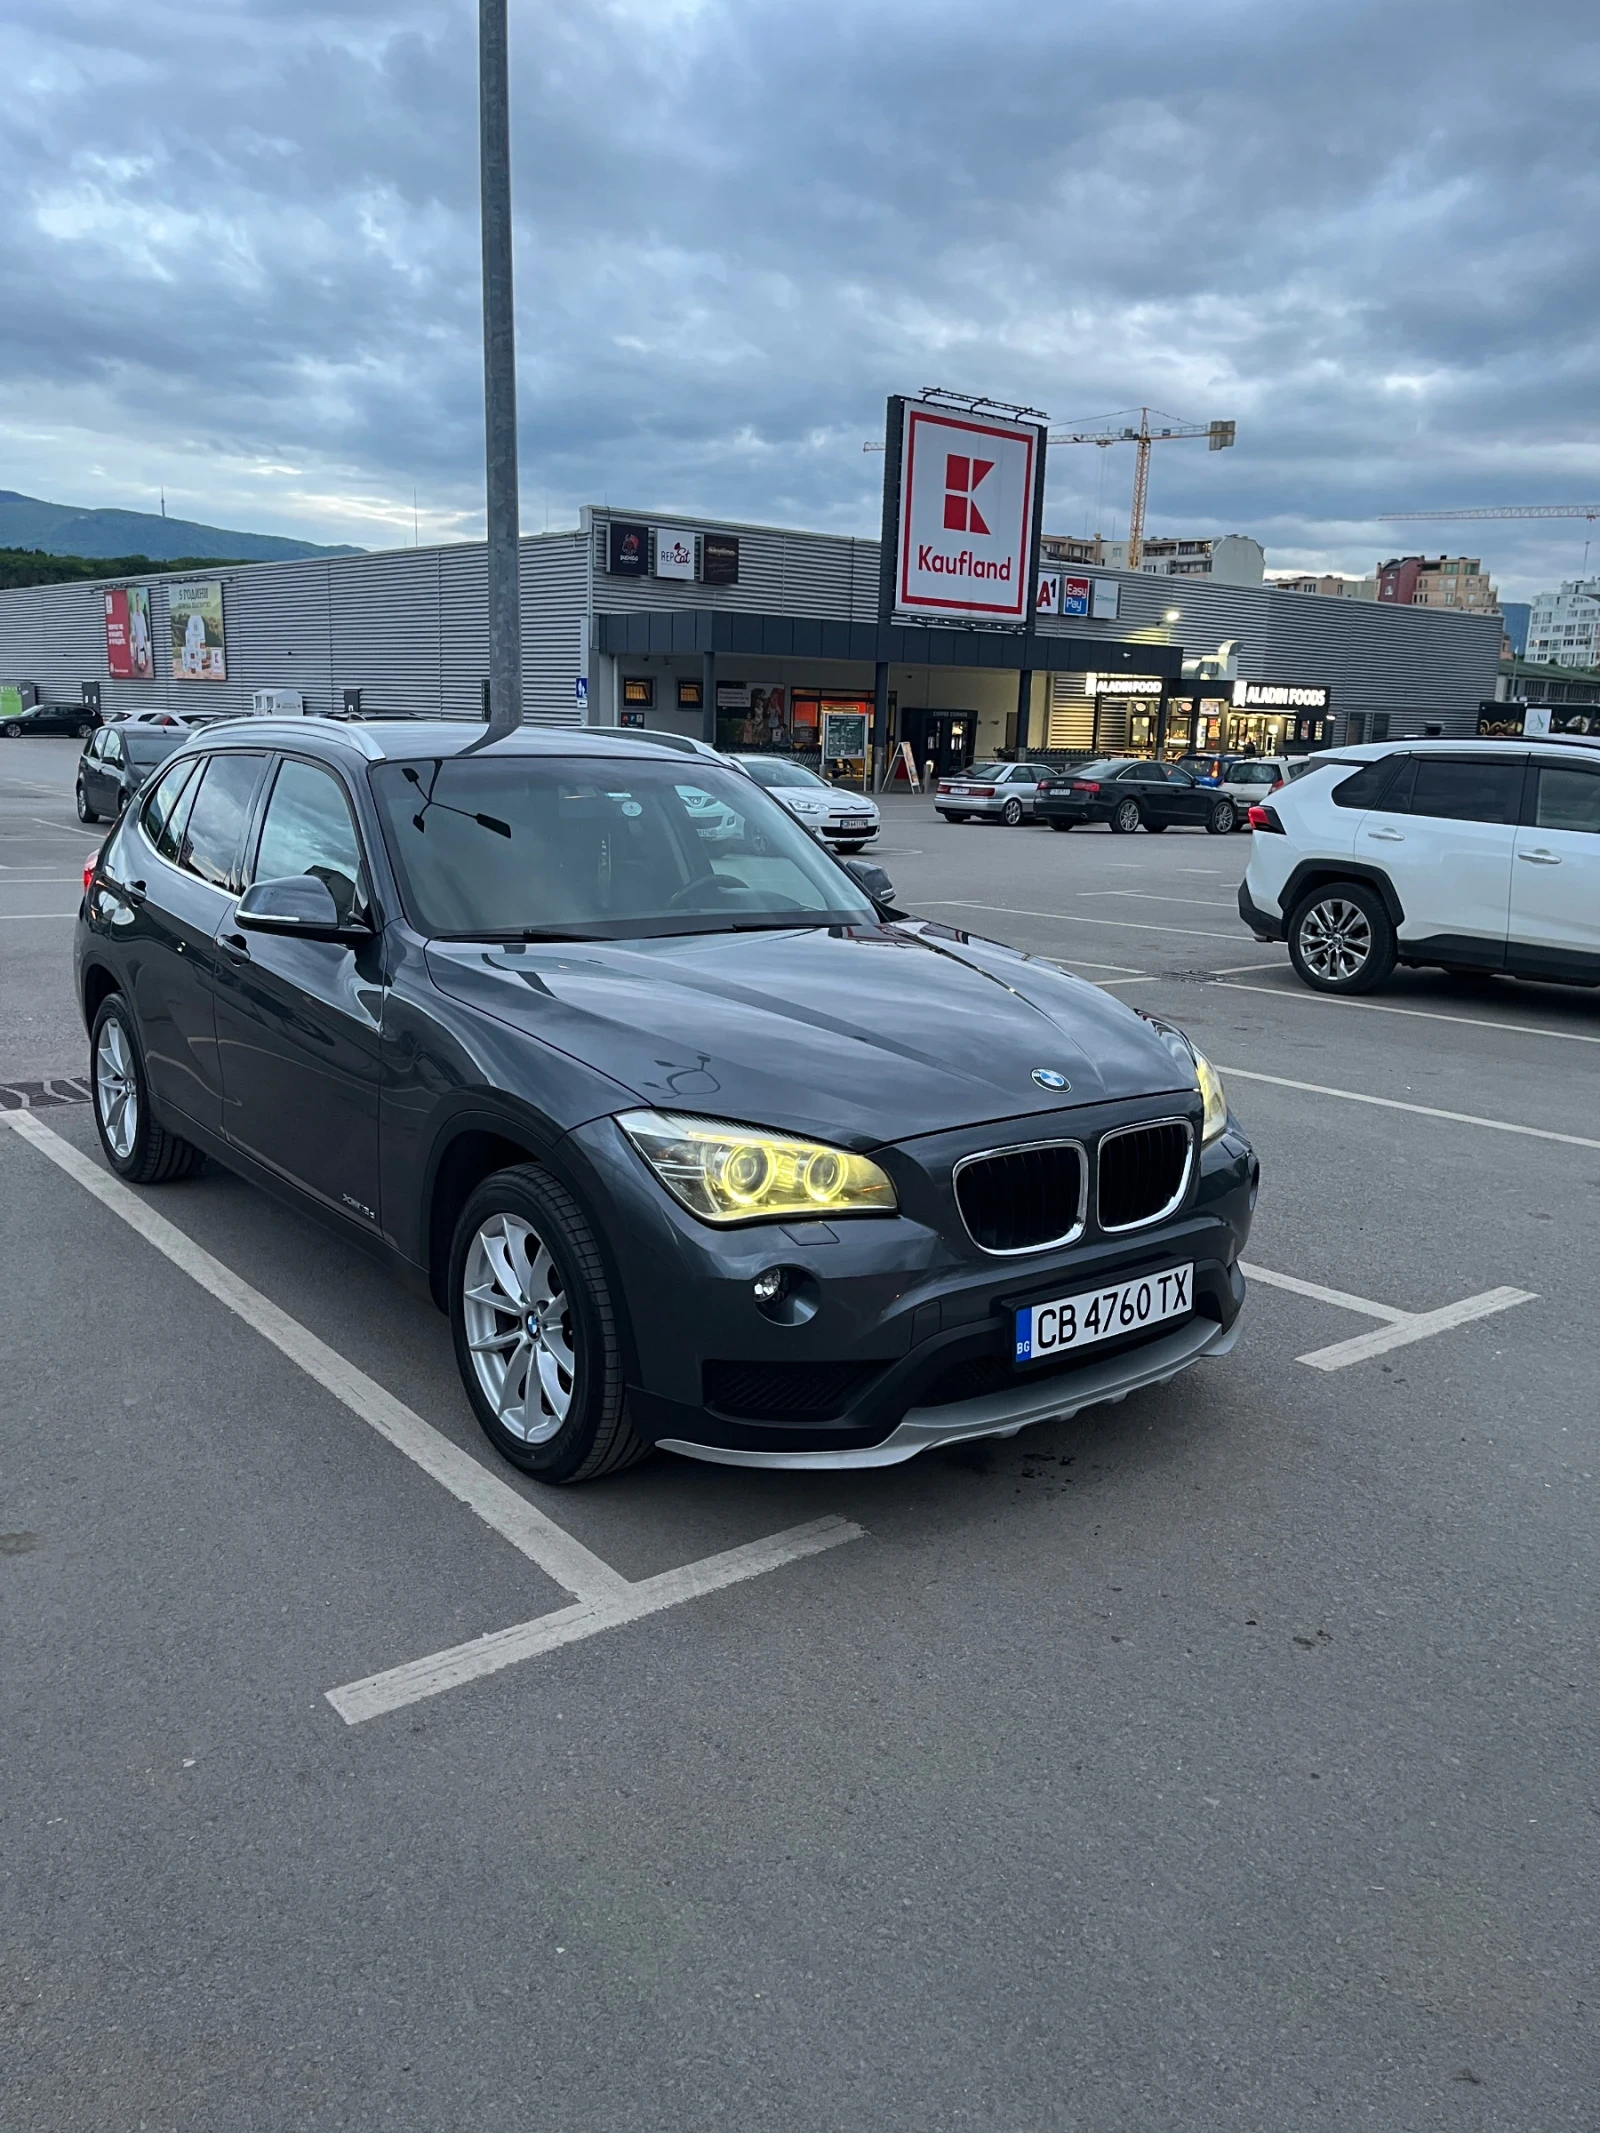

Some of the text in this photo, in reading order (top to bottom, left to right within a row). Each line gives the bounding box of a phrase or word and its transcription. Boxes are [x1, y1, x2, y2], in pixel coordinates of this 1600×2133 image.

[918, 544, 1011, 582] Kaufland
[1036, 578, 1057, 607] A1
[1067, 583, 1087, 599] Easy
[1066, 597, 1082, 612] Pay
[1096, 680, 1132, 693] ALADIN
[1246, 686, 1326, 706] ALADIN FOODS
[1037, 1269, 1188, 1349] CB 4760 TX
[1016, 1340, 1031, 1355] BG
